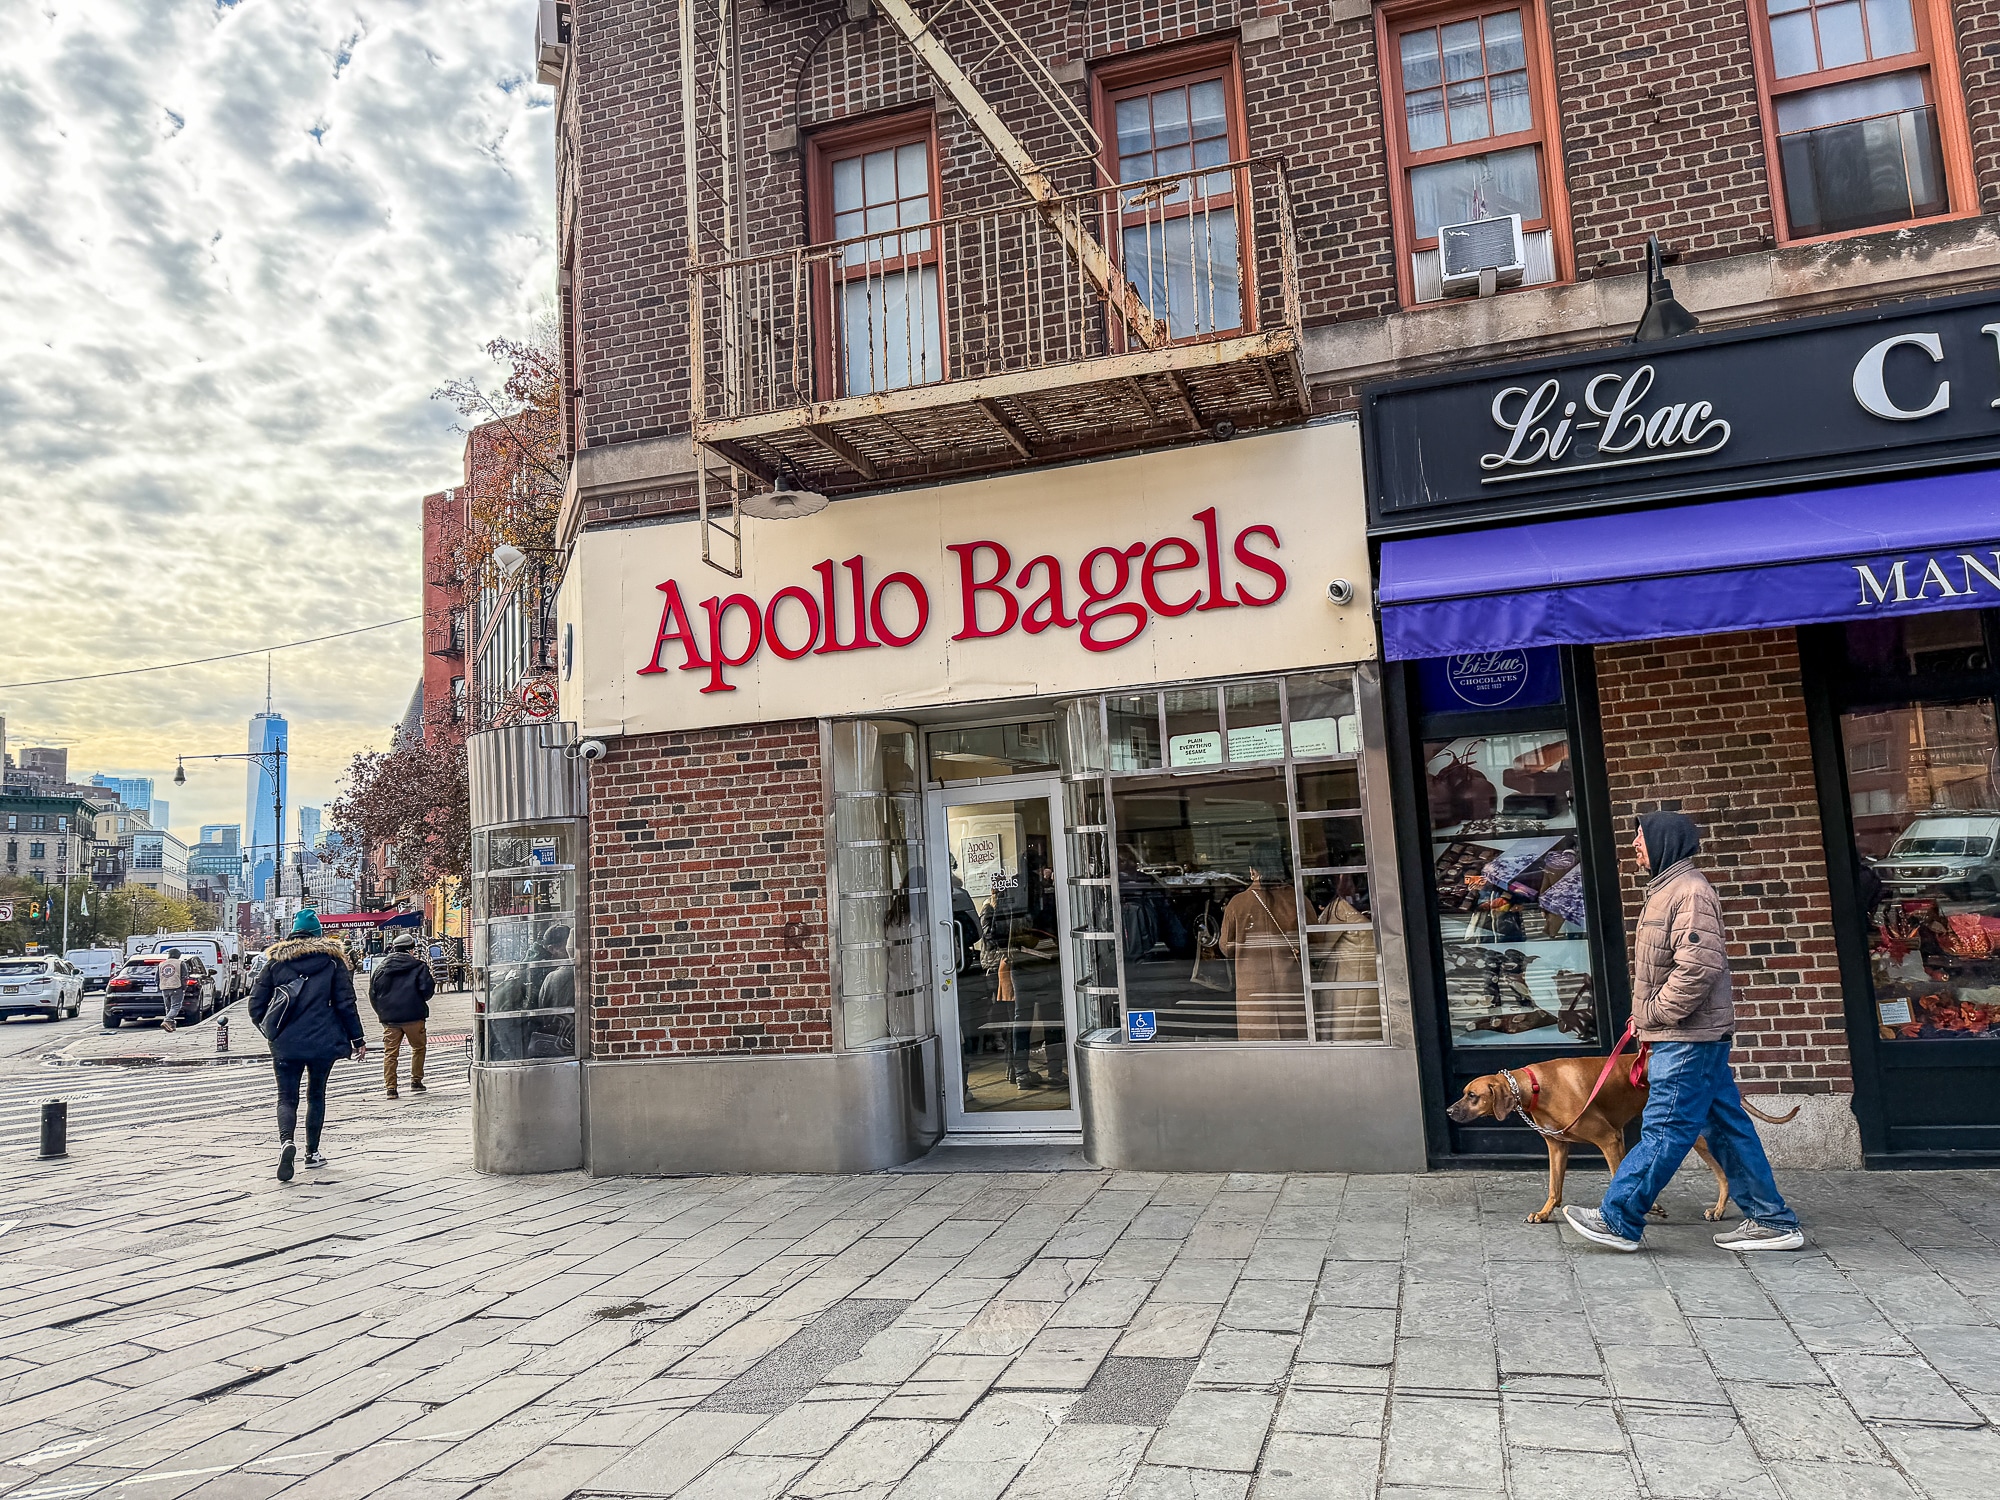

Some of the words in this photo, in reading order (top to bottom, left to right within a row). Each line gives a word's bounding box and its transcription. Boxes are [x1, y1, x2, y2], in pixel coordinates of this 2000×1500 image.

[1480, 365, 1731, 471] Li-Lac
[636, 554, 929, 695] Apollo
[945, 506, 1288, 653] Bagels
[1459, 675, 1518, 686] CHOCOLATES
[1179, 742, 1212, 751] EVERYTHING
[967, 840, 994, 854] Apollo
[968, 851, 995, 864] Bagels
[991, 865, 1018, 881] pollo
[991, 878, 1018, 892] agels
[341, 920, 375, 929] VANGUARD
